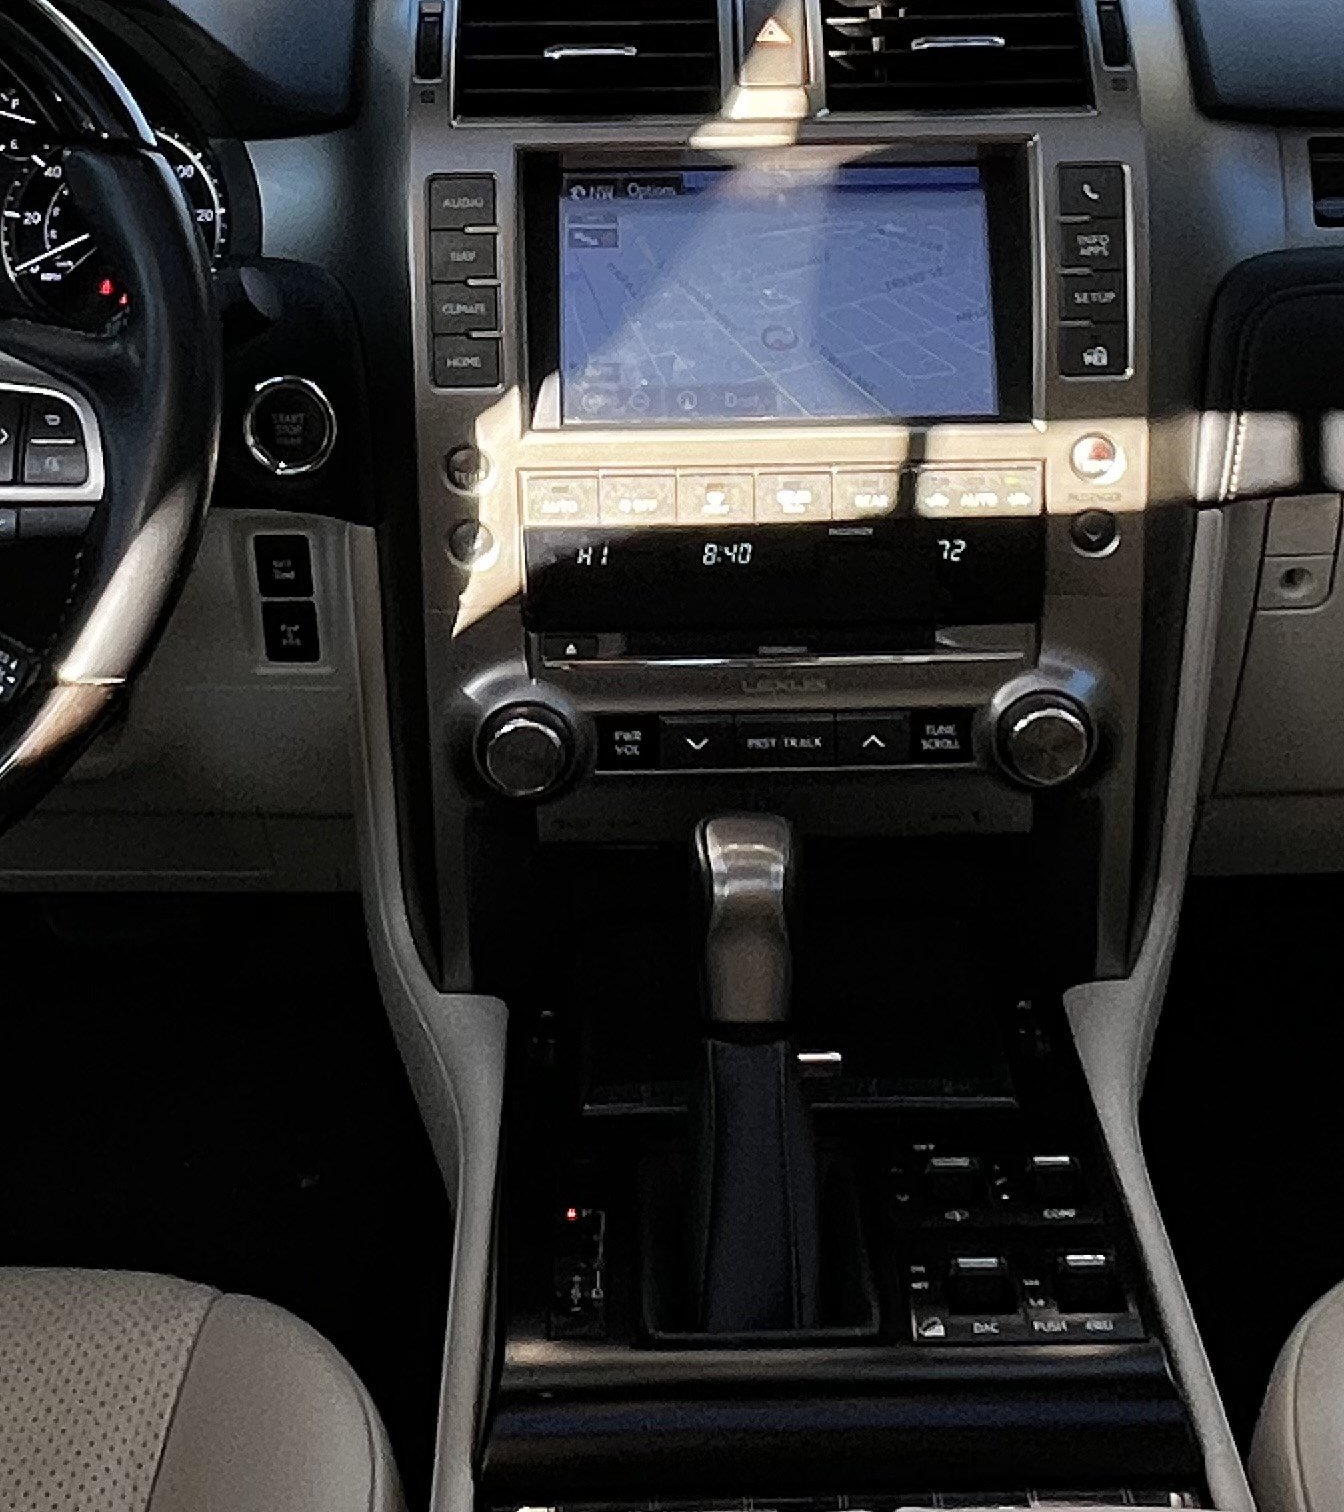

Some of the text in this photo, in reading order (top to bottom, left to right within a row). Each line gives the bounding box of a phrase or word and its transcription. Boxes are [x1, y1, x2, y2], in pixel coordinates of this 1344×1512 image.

[44, 165, 62, 180] 40
[22, 210, 42, 226] 20
[446, 356, 482, 368] HOME
[702, 542, 753, 566] 8:40
[937, 539, 968, 561] 72
